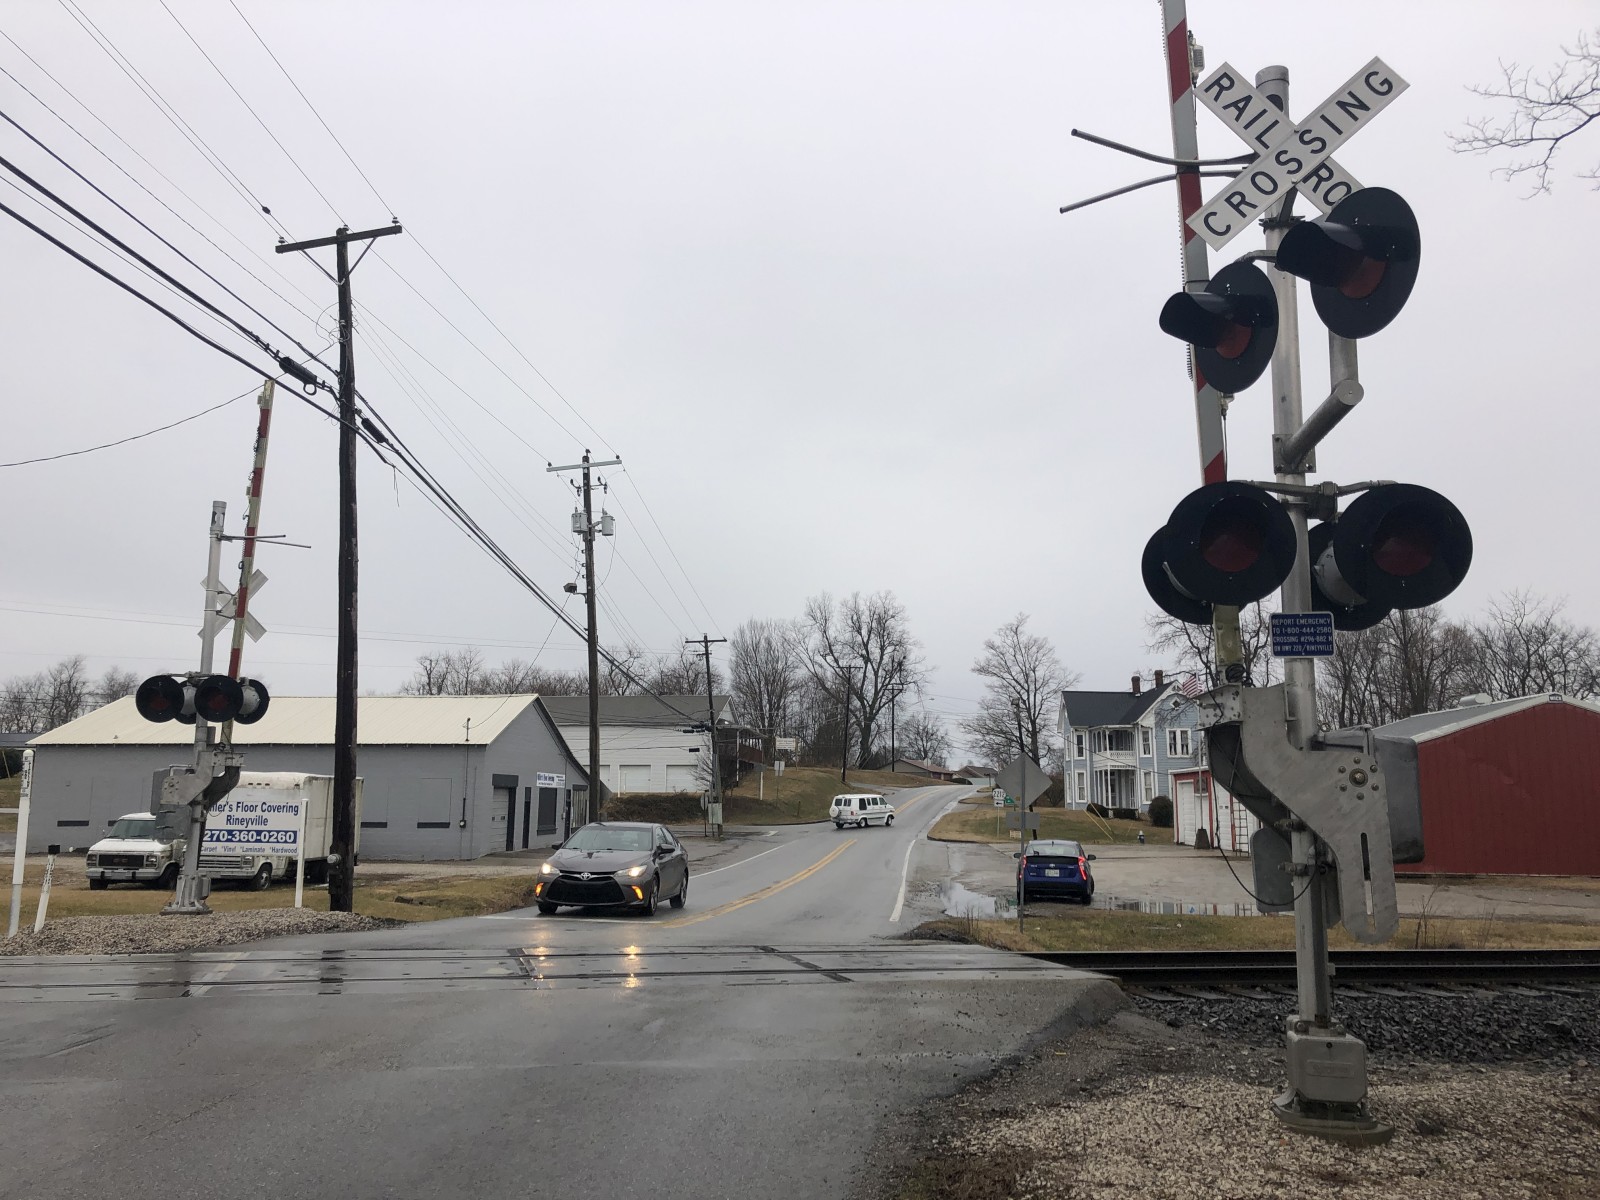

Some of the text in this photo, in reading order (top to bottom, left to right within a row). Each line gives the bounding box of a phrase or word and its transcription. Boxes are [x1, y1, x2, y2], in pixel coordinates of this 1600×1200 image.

[1204, 72, 1352, 207] RAIL RO
[1203, 70, 1394, 237] CROSSING
[235, 801, 258, 813] Floor
[260, 802, 299, 816] Covering
[225, 815, 269, 828] Rineyville
[203, 830, 295, 842] 270-360-0260
